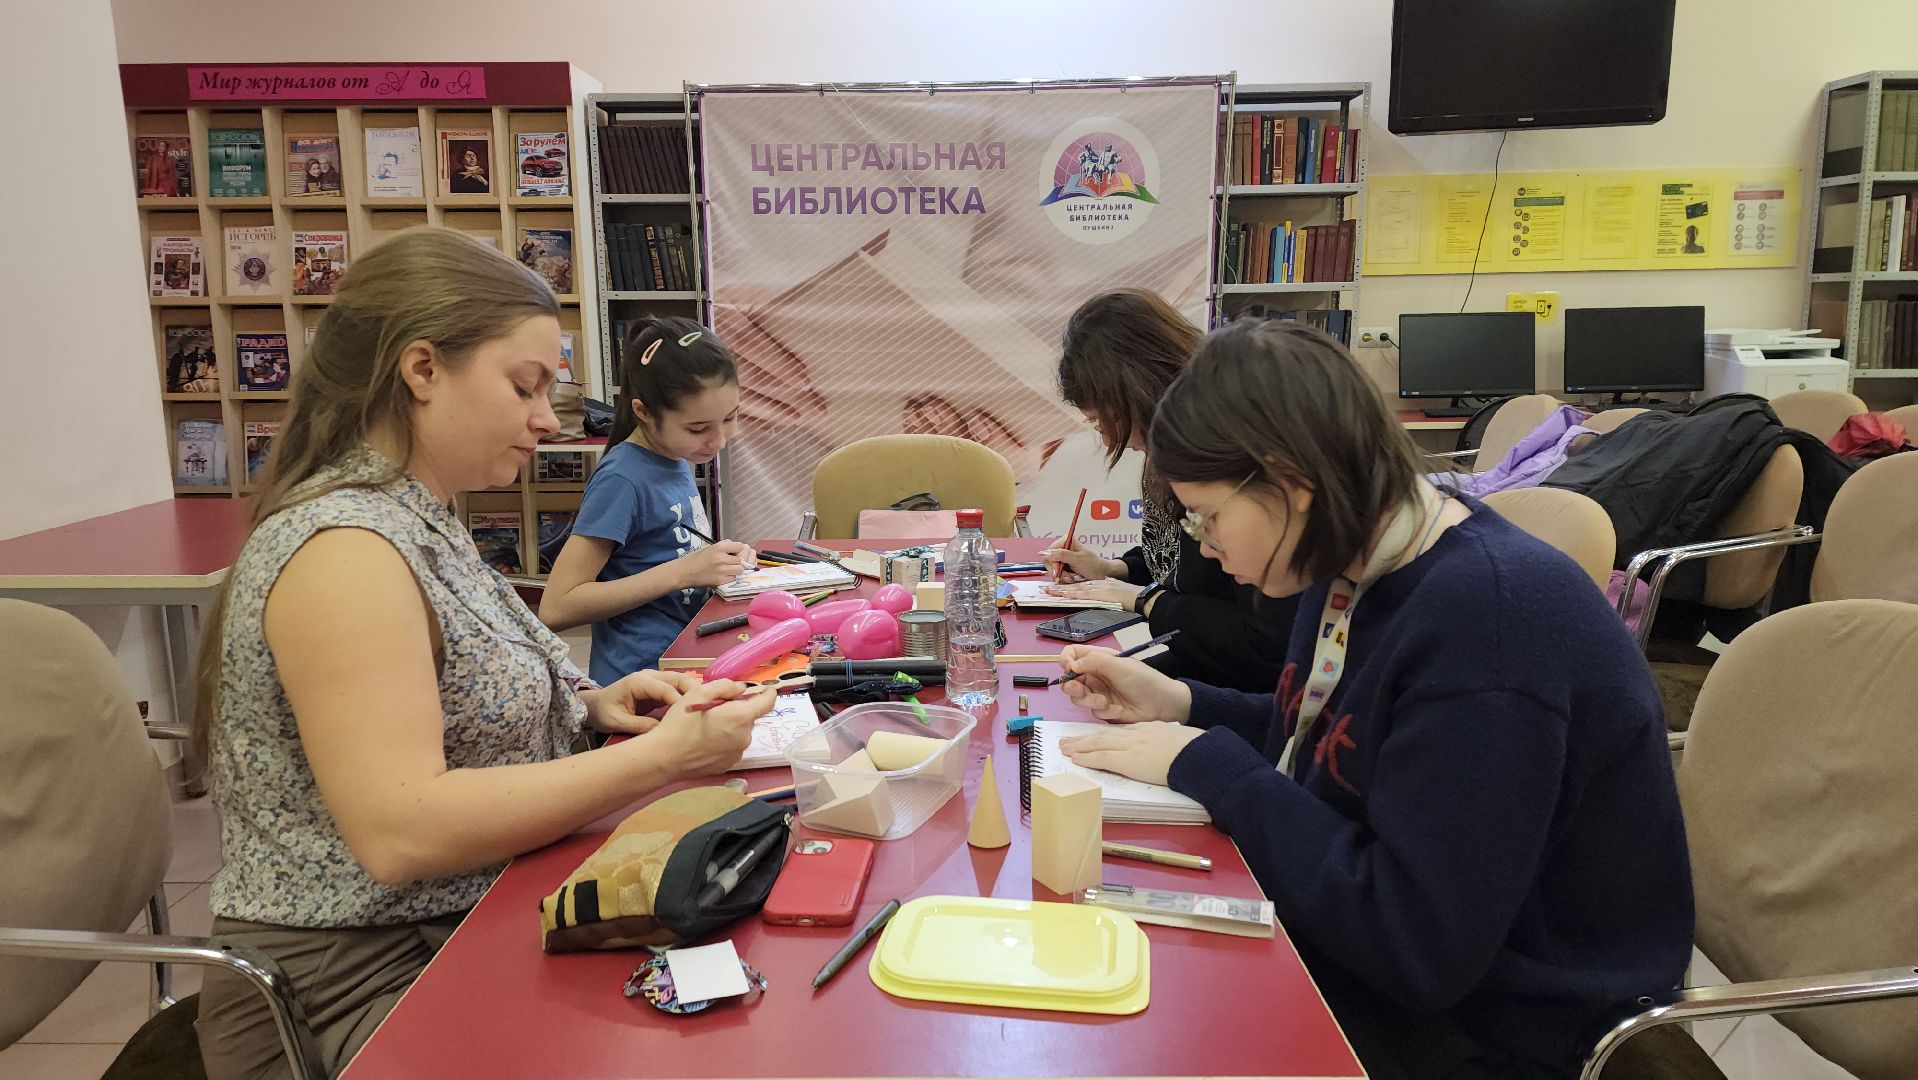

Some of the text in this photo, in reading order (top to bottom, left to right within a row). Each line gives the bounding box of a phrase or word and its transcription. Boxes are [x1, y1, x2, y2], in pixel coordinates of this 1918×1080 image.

[200, 72, 241, 95] Мир
[245, 75, 337, 95] журналов
[341, 77, 369, 89] от
[419, 71, 440, 89] до
[445, 70, 472, 95] Я
[520, 137, 566, 148] За рулем
[167, 149, 189, 159] style
[750, 141, 1006, 176] ЦЕНТРАЛЬНАЯ
[752, 186, 987, 215] БИБЛИОТЕКА
[1066, 203, 1133, 212] ЦЕНТРАЛЬНАЯ
[1069, 213, 1130, 222] БИБЛИОТЕКА
[229, 232, 276, 241] ИСТОРИК
